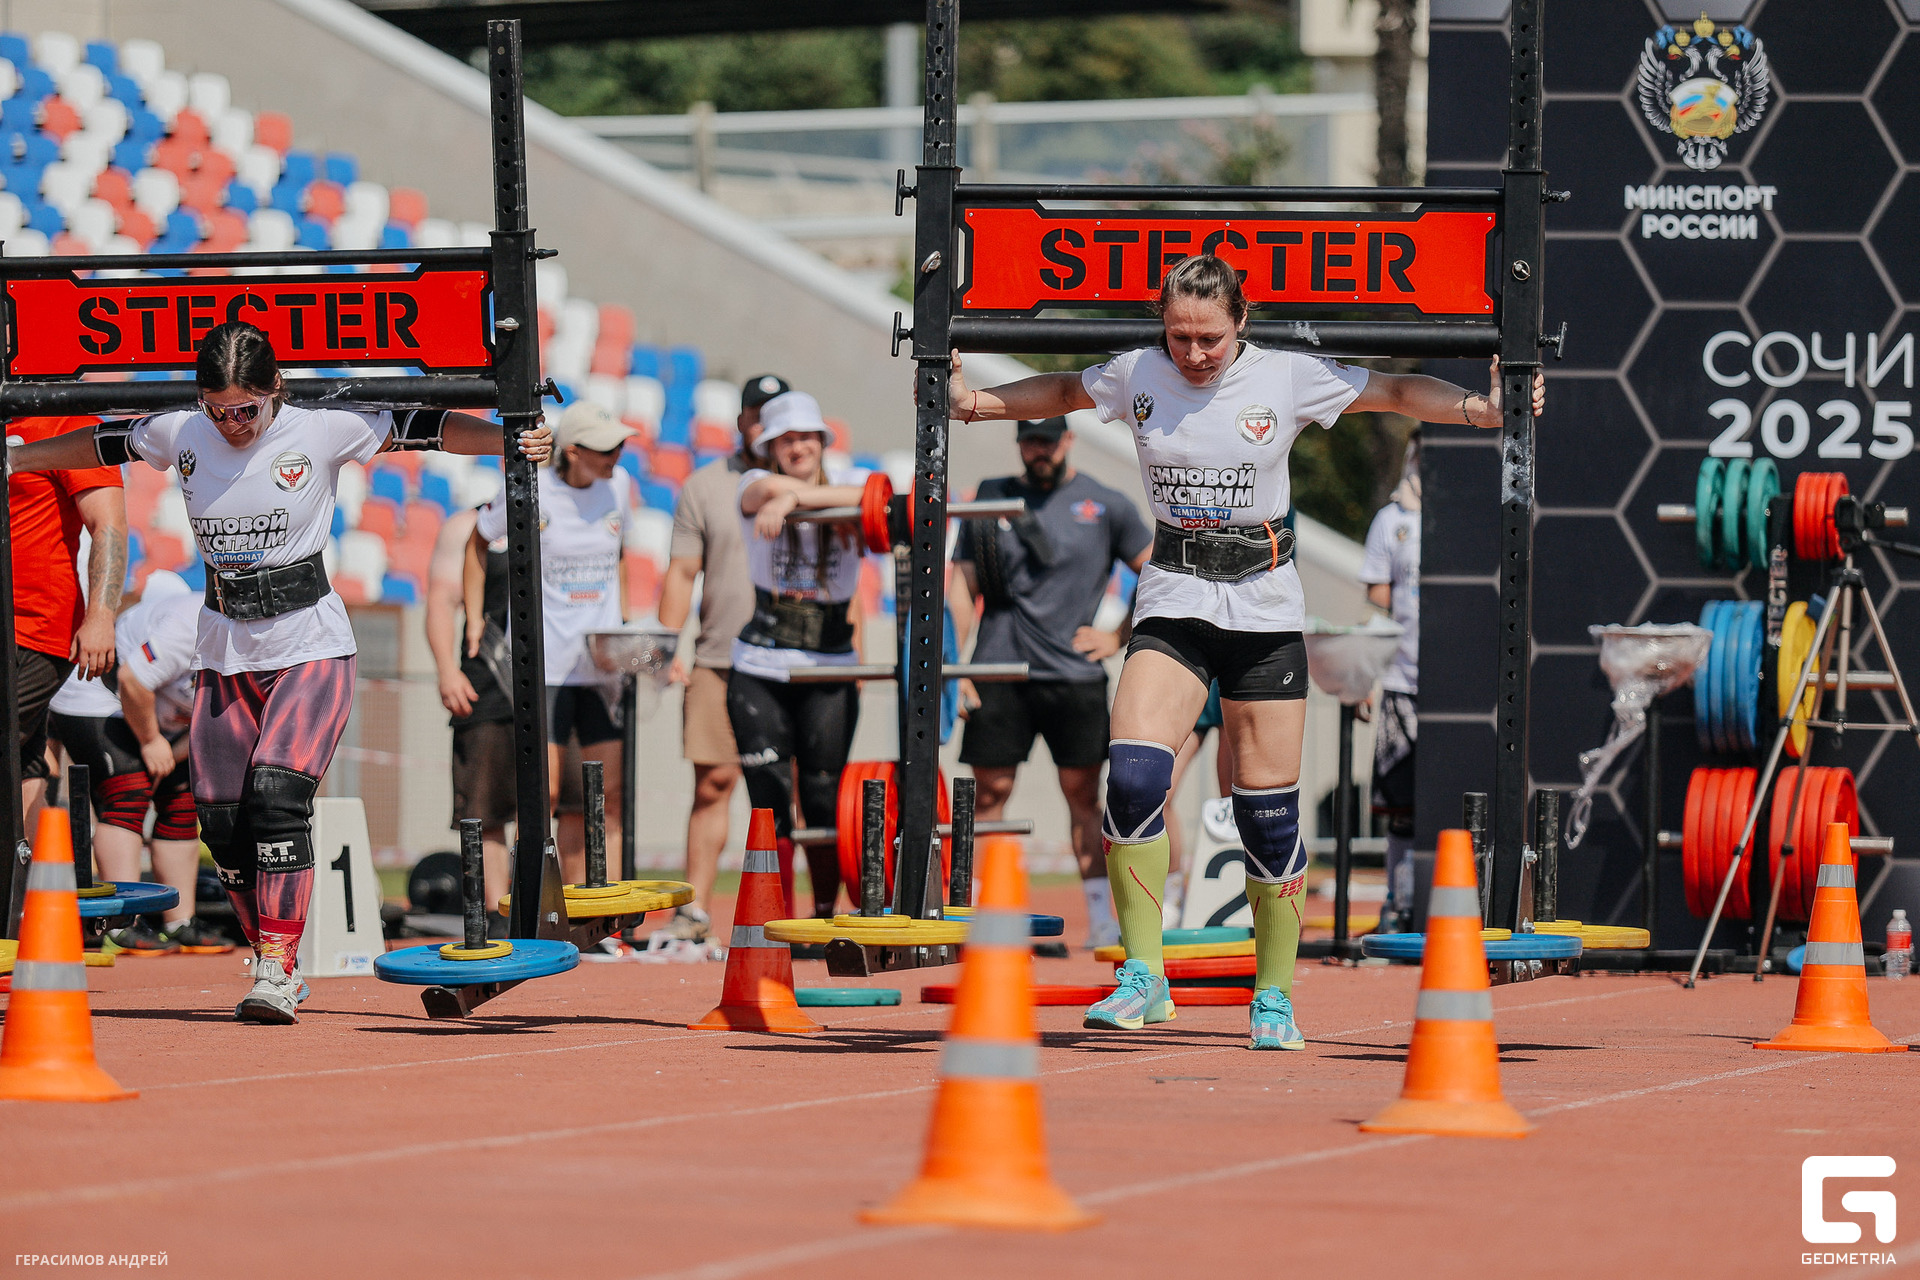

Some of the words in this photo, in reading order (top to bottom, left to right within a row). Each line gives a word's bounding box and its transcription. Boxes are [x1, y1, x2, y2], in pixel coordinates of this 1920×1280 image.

[1624, 185, 1778, 210] МИНСПОРТ
[1641, 213, 1758, 239] РОССИИ
[1702, 330, 1915, 388] СОЧИ
[1707, 398, 1915, 460] 2025
[1149, 463, 1257, 487] СИЛОВОЙ
[1152, 483, 1254, 507] ЭКСТРИМ
[1172, 507, 1230, 520] ЧЕМПИОНАТ
[331, 845, 355, 932] 1
[1204, 849, 1250, 928] 2
